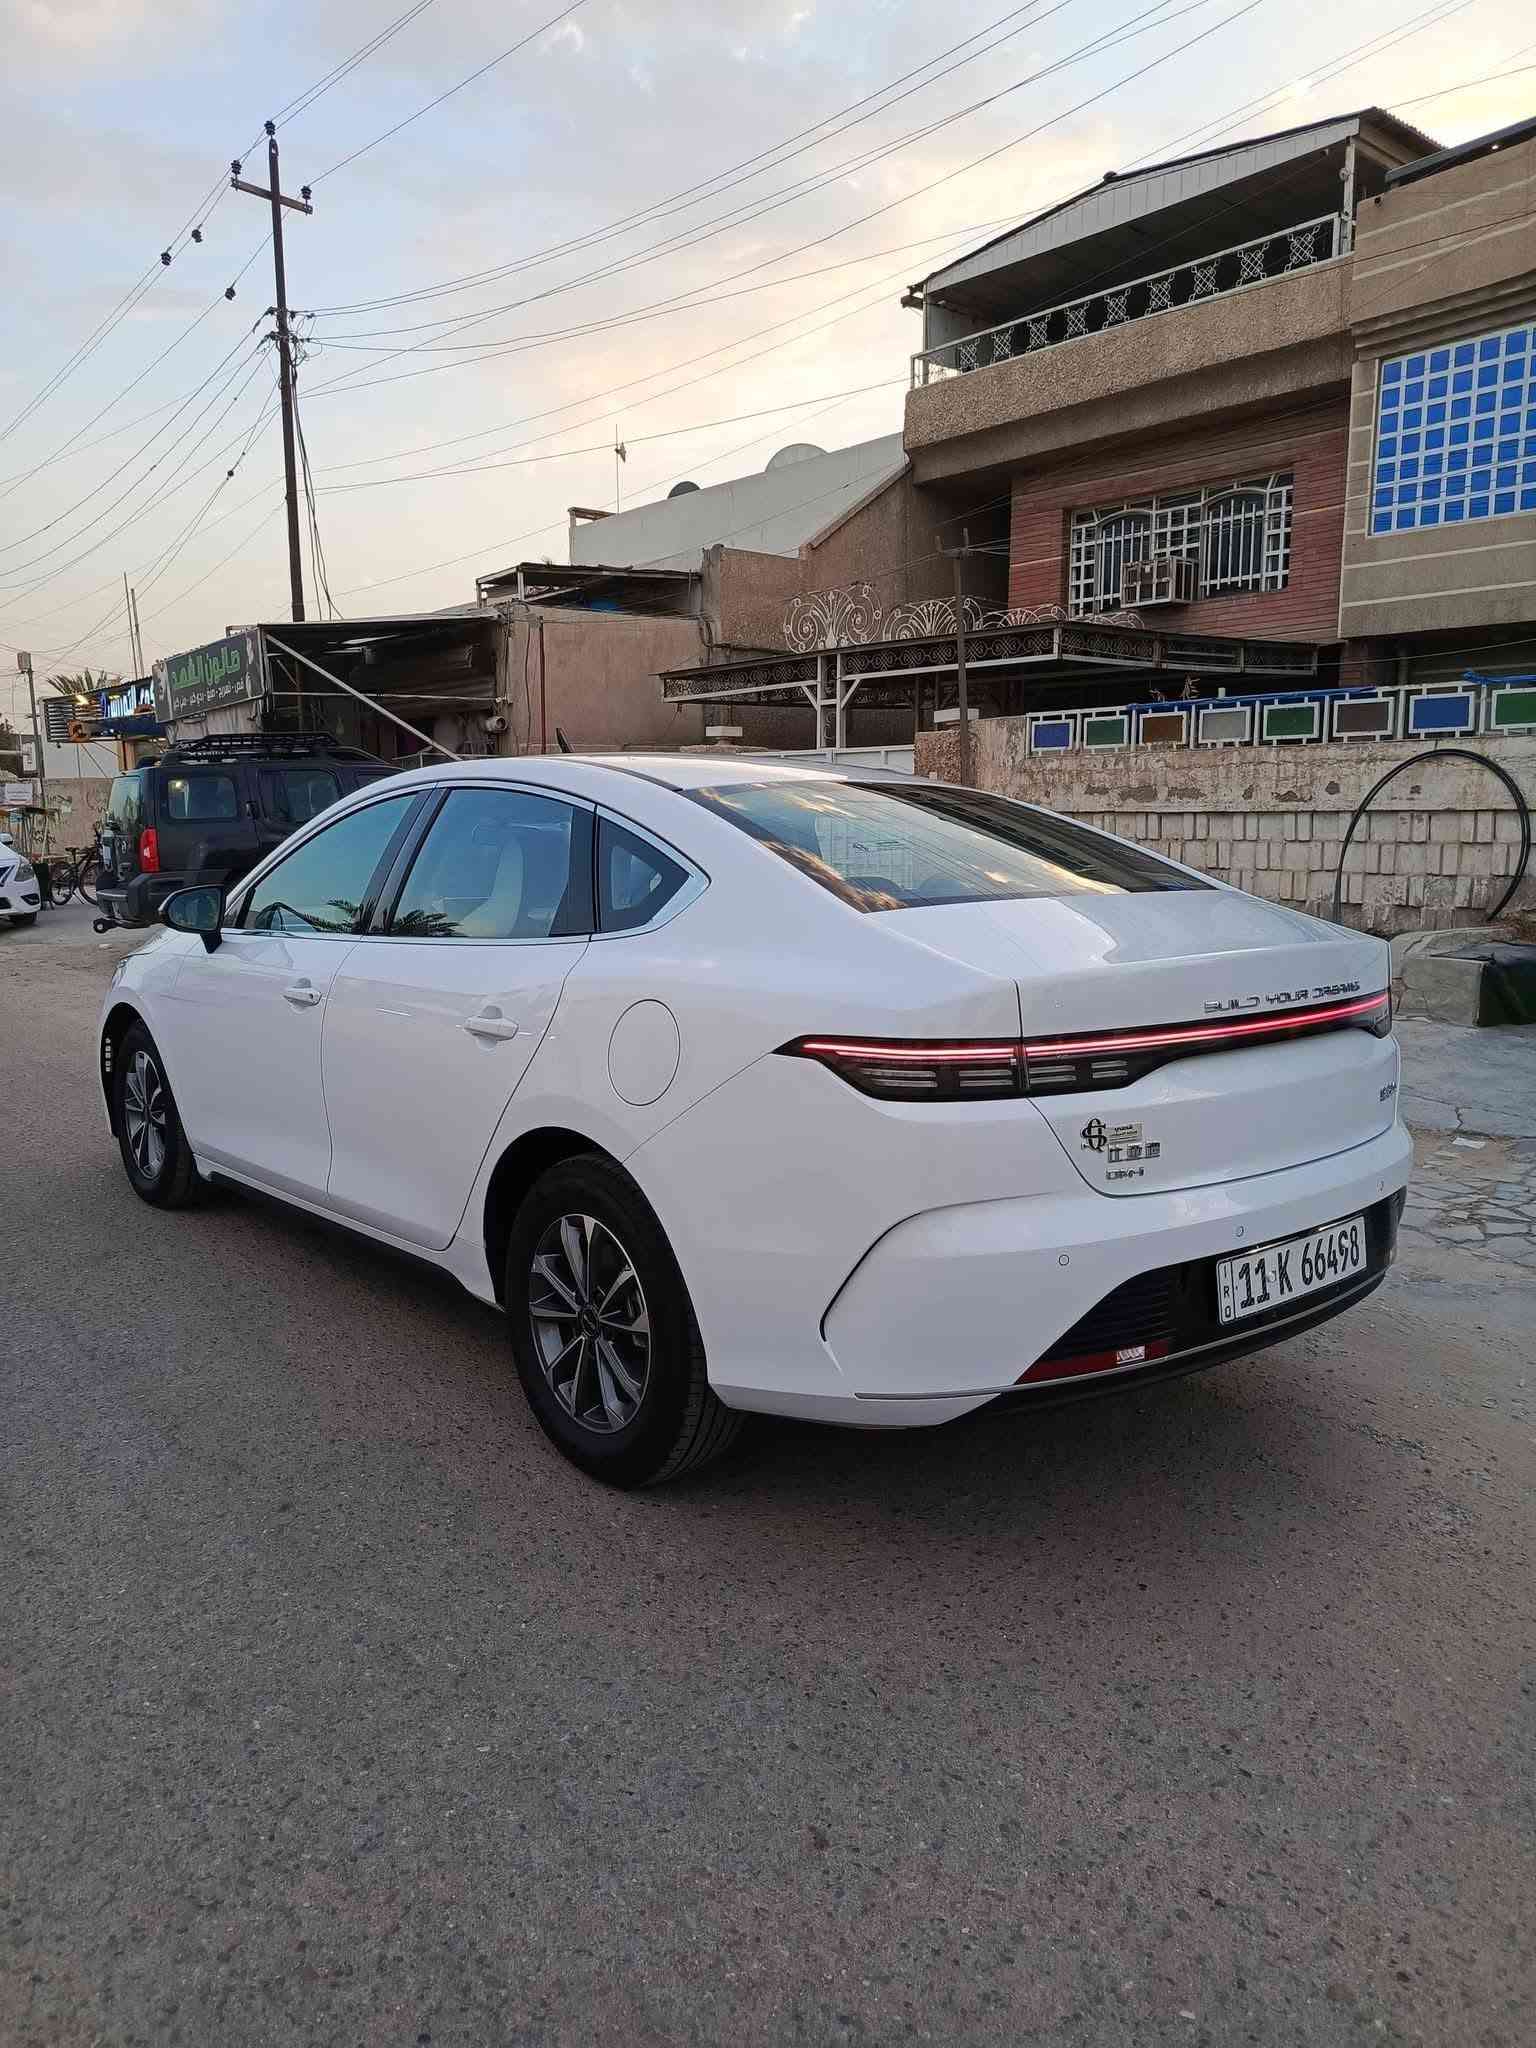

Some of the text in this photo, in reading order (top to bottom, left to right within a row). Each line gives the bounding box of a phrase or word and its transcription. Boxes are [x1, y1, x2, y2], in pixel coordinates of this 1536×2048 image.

[1204, 996, 1261, 1014] BUILD
[1266, 988, 1309, 1005] YOUR
[1239, 1225, 1360, 1309] 11 K 66498
